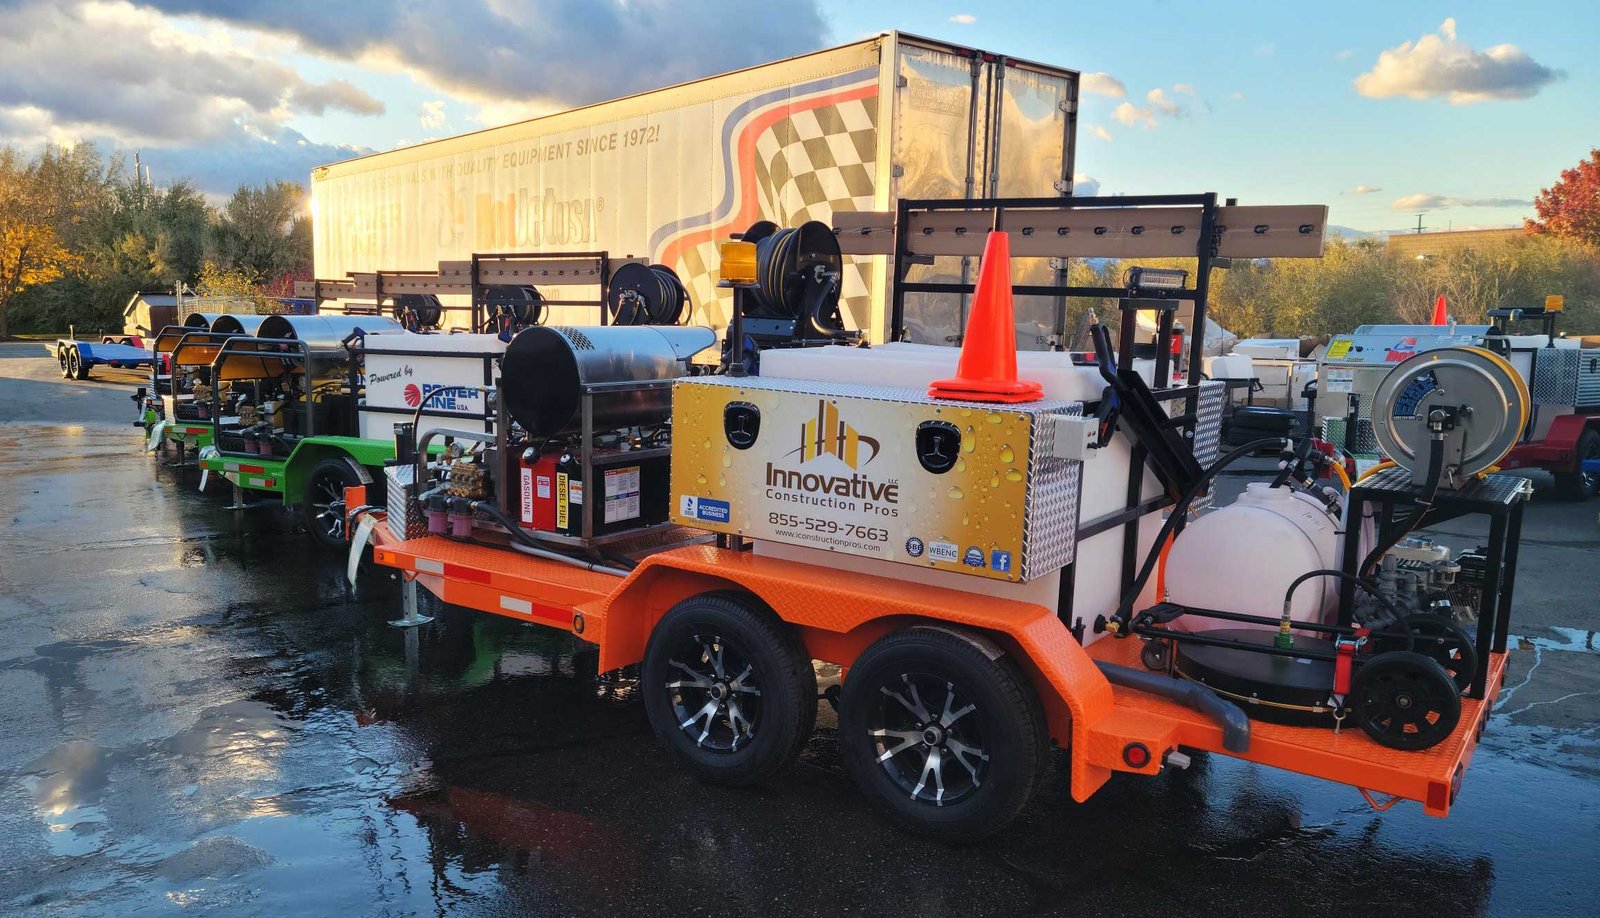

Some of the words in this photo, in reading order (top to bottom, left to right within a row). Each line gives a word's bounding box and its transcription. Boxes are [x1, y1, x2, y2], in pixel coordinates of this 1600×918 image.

[457, 154, 499, 178] QUALITY
[502, 141, 572, 169] EQUIPMENT
[576, 132, 618, 156] SINCE
[623, 124, 661, 148] 1972!
[369, 367, 402, 385] Powered
[404, 364, 414, 377] by
[422, 383, 479, 399] POWER
[523, 474, 531, 515] GASOLINE
[765, 462, 899, 504] Innovative
[765, 488, 856, 511] Construction
[863, 502, 899, 518] Pros
[768, 512, 889, 543] 855-529-7663
[775, 529, 881, 552] www.iconstructionpros.com
[929, 546, 957, 558] WBENC
